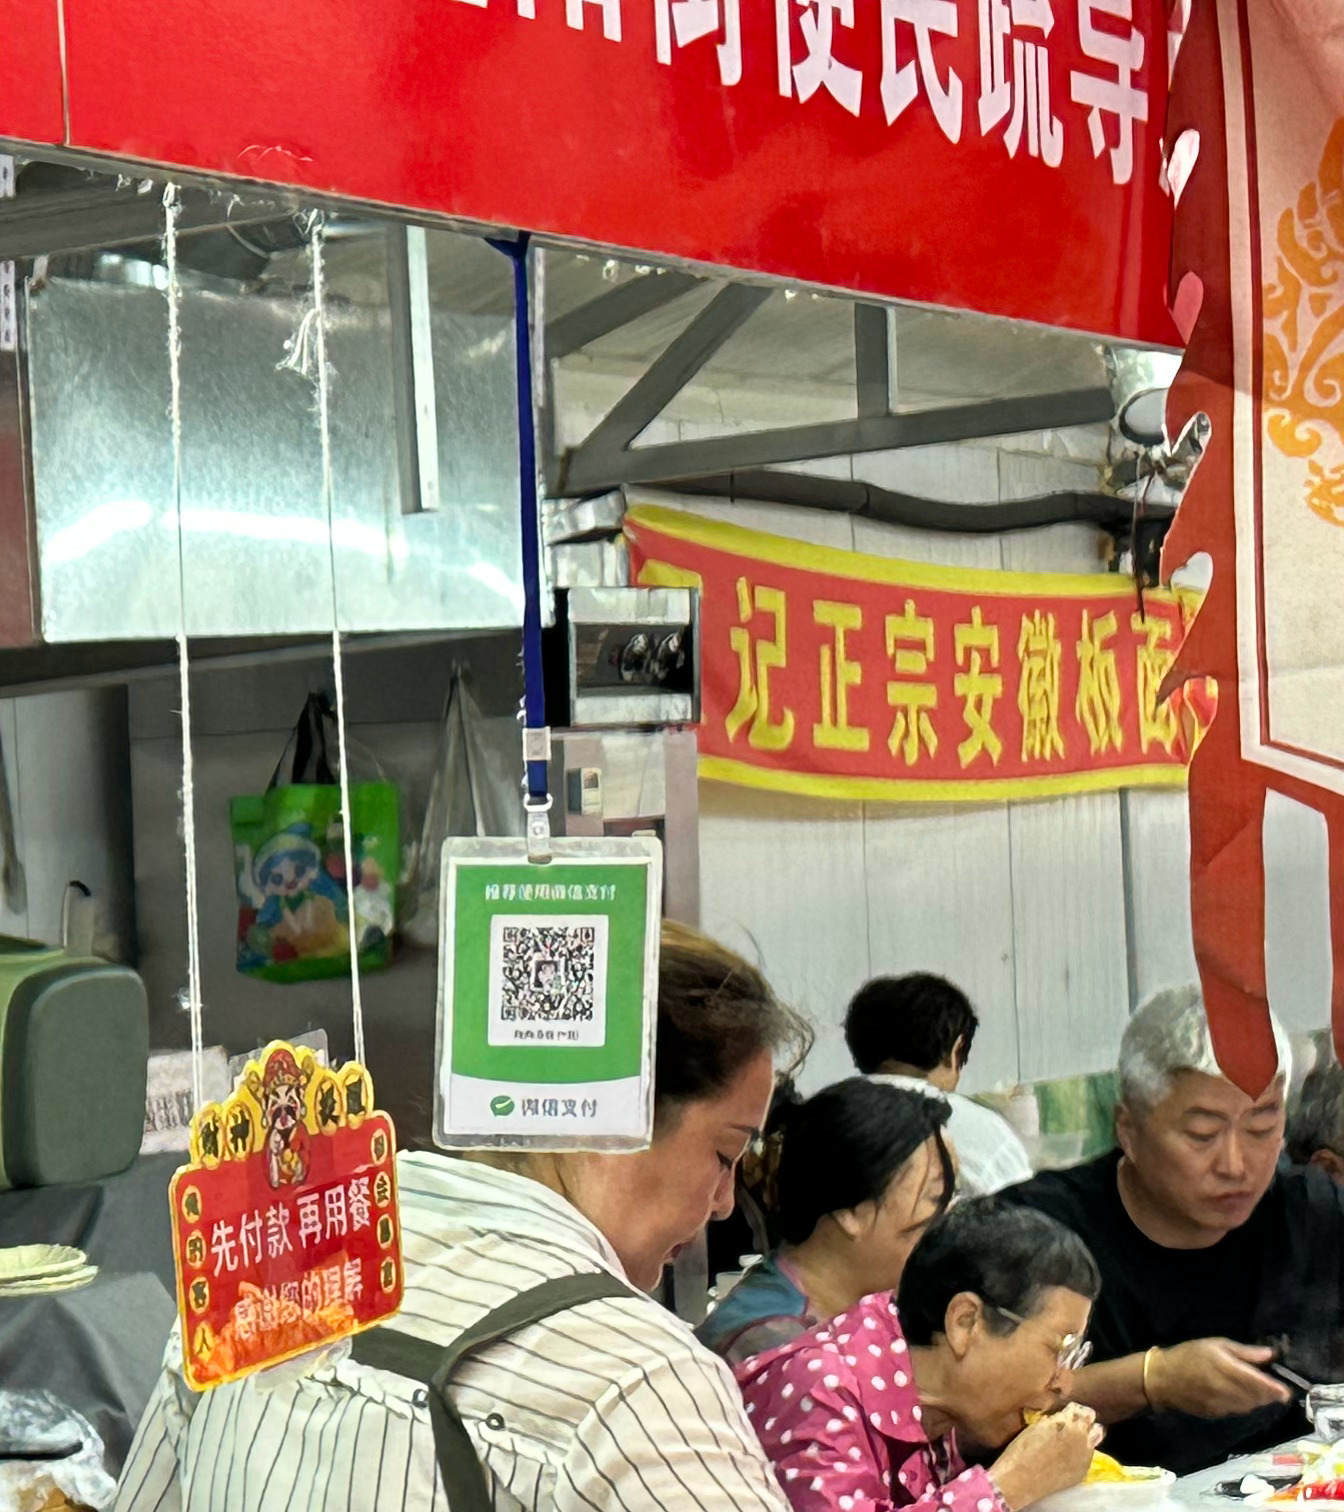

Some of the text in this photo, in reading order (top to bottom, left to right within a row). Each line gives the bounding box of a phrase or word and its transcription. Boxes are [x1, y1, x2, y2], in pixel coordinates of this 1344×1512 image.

[638, 560, 1180, 769] 记正宗安徽板面
[210, 1201, 294, 1278] 先付款
[295, 1175, 372, 1250] 再用餐
